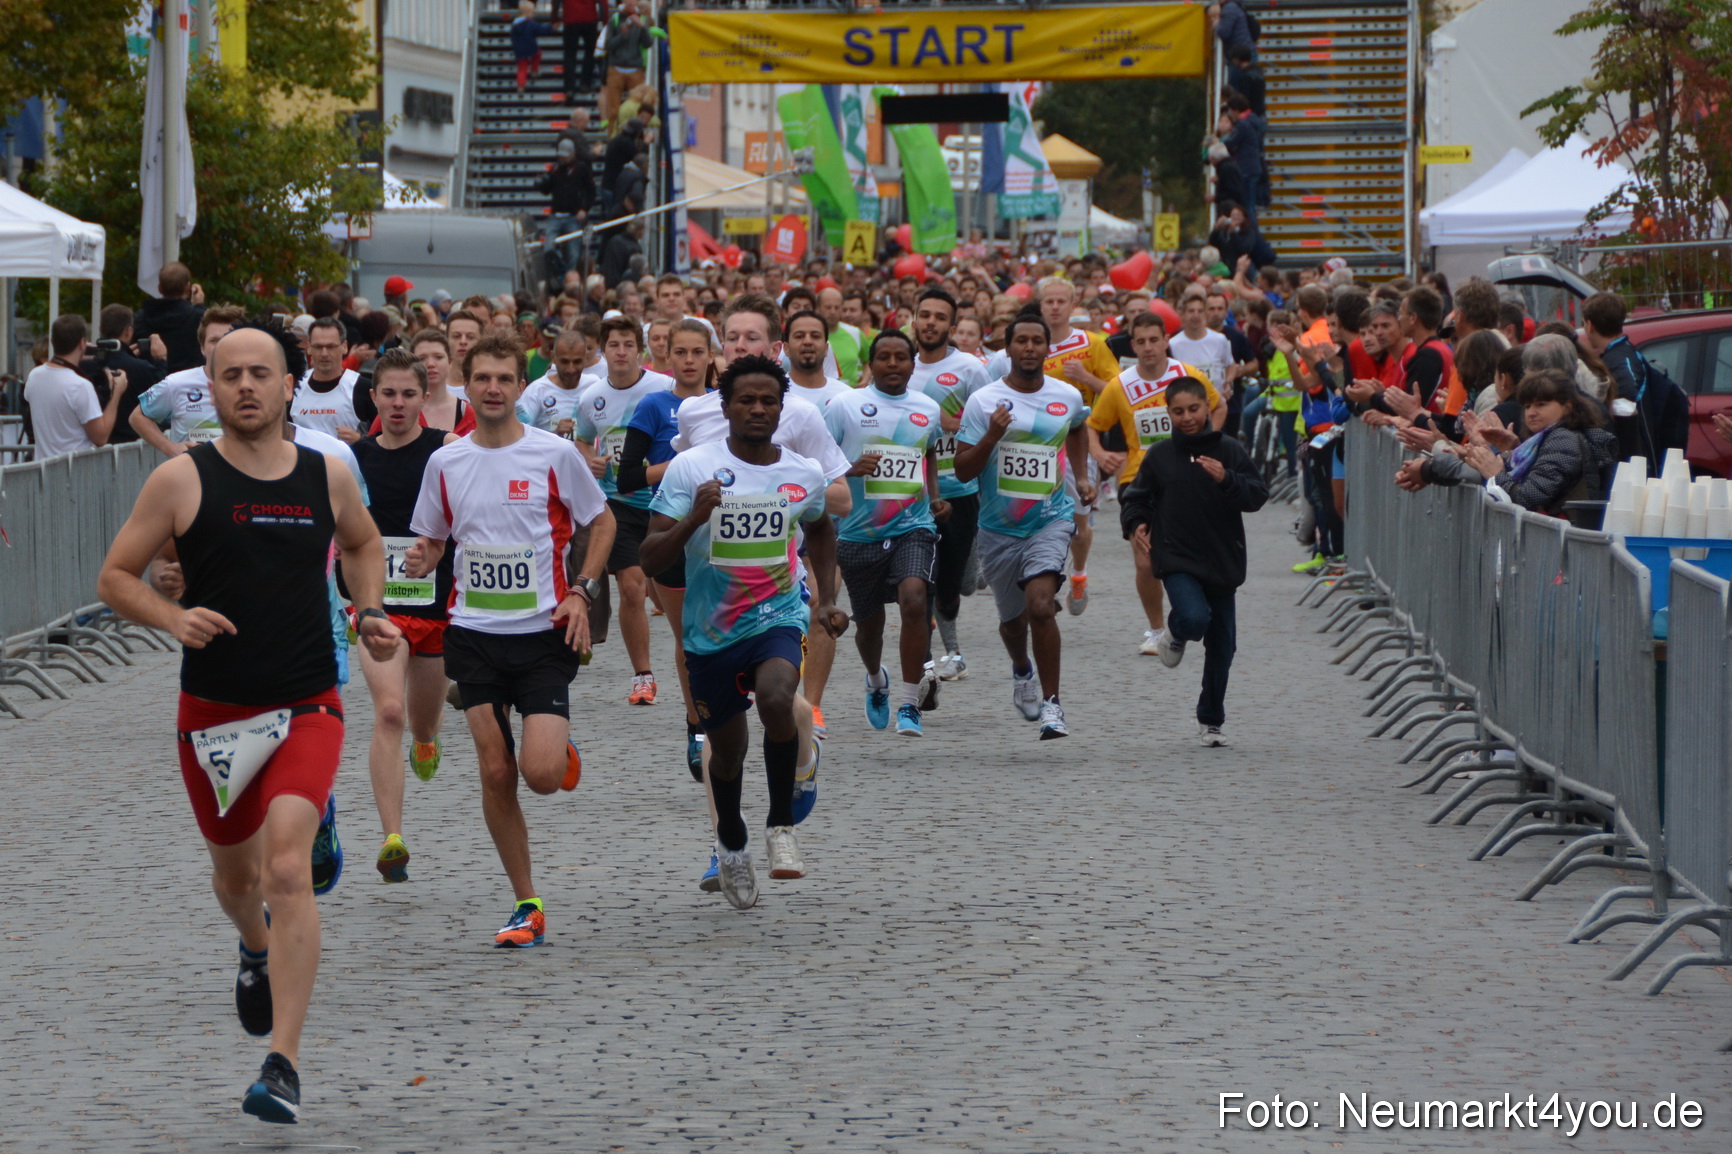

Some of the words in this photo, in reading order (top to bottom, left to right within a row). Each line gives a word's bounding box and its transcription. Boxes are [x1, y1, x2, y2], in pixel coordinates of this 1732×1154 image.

[843, 24, 1025, 67] START
[1159, 224, 1173, 242] C
[851, 233, 866, 255] A
[1141, 417, 1170, 434] 516
[886, 450, 913, 458] Neumarkt
[1000, 446, 1018, 454] PARTL
[1020, 448, 1047, 456] Neumarkt
[1003, 456, 1049, 479] 5331
[250, 504, 312, 517] CHOOZA
[718, 502, 740, 510] ARTL
[741, 501, 777, 509] Neumarkt
[720, 511, 784, 539] 5329
[464, 549, 484, 558] PARTL
[485, 551, 522, 560] Neumarkt
[470, 561, 530, 590] 5309
[196, 735, 230, 750] PARTL
[209, 749, 235, 780] 5
